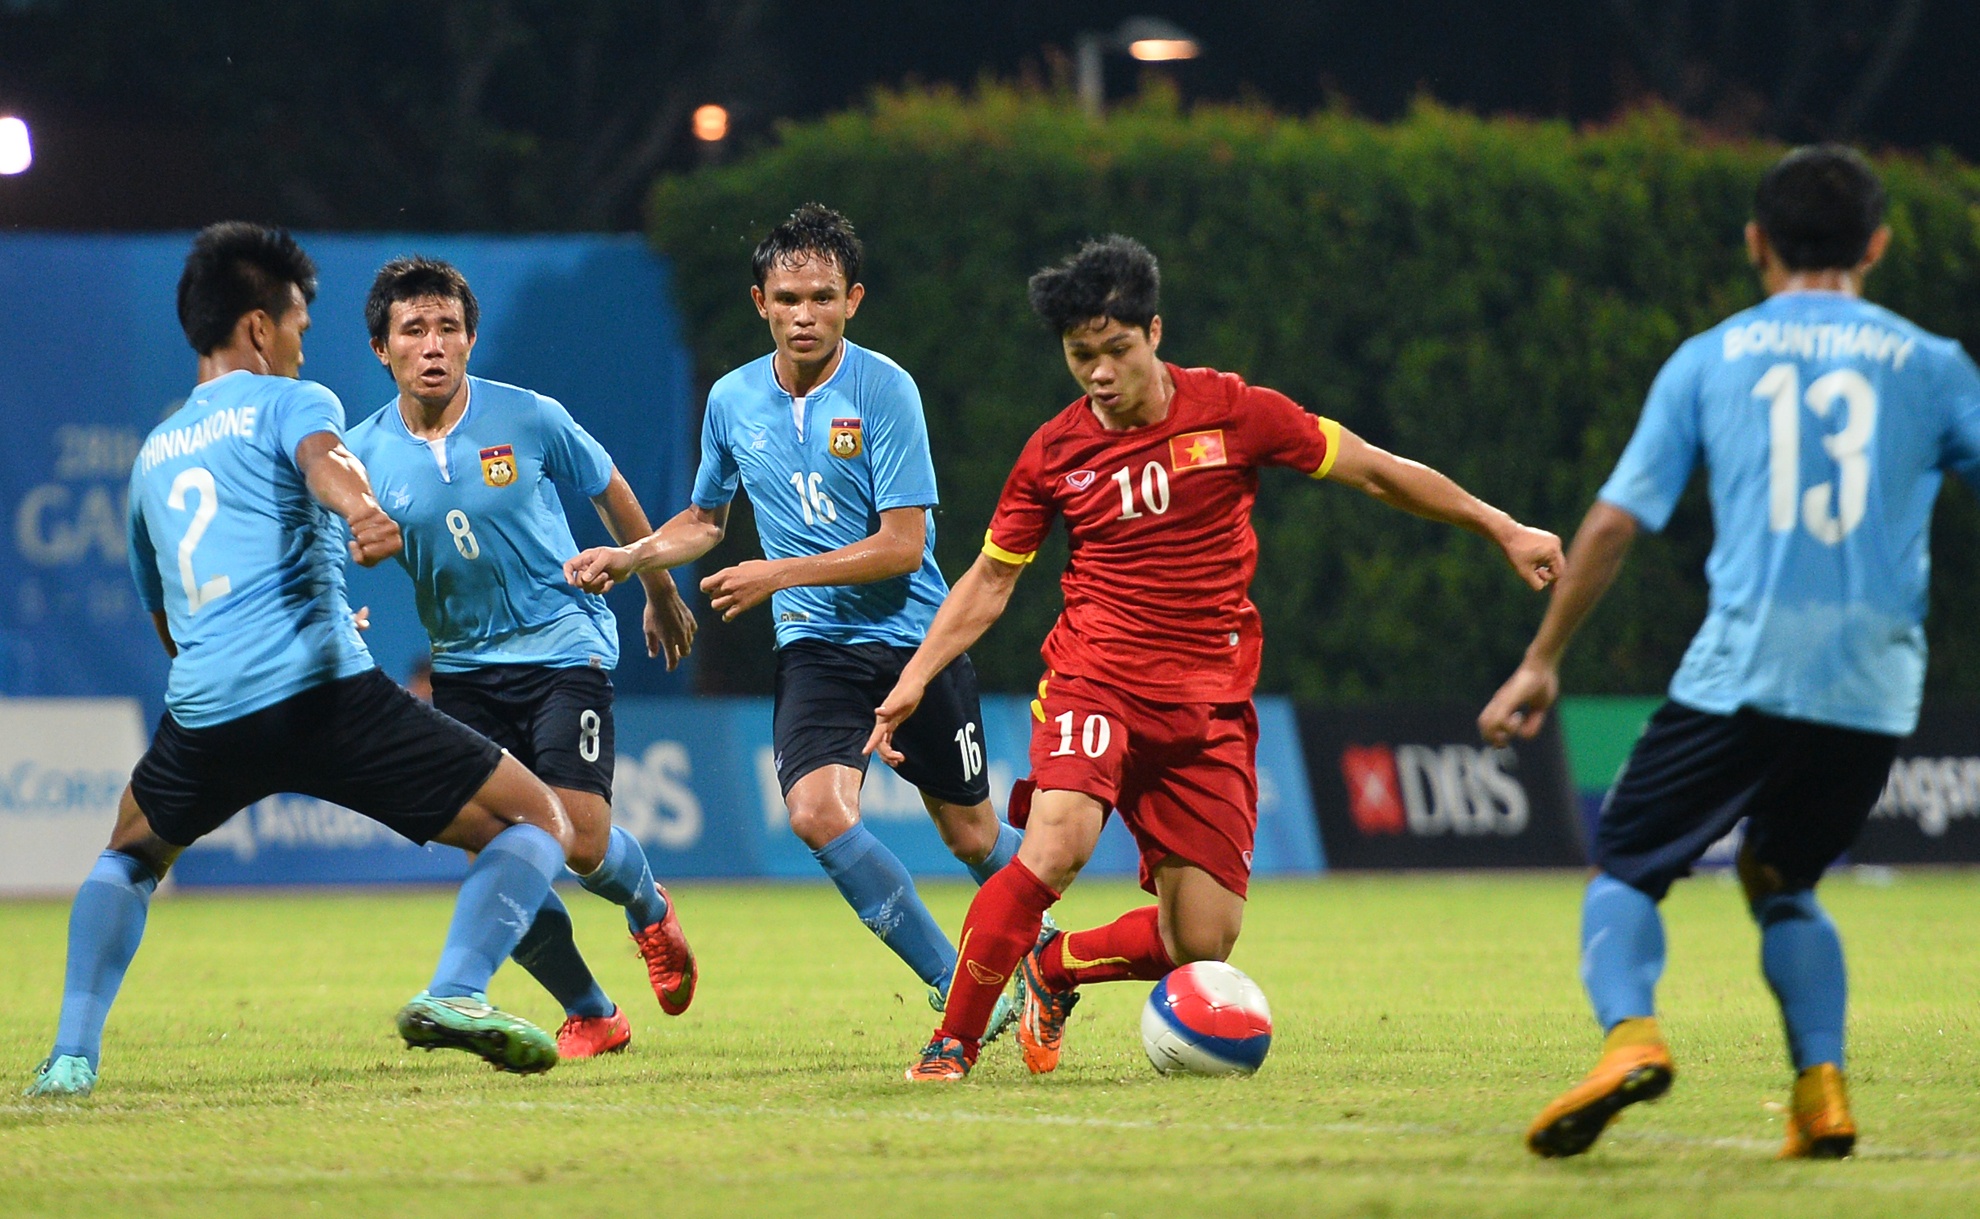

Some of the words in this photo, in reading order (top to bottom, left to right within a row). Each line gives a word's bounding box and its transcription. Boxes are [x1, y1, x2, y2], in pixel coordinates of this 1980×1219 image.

[1751, 363, 1877, 545] 13
[790, 471, 837, 526] 16
[1111, 460, 1170, 521] 10
[167, 466, 232, 616] 2
[446, 508, 480, 560] 8
[579, 709, 601, 763] 8
[954, 721, 982, 783] 16
[1050, 710, 1111, 758] 10
[1396, 744, 1529, 837] DBS
